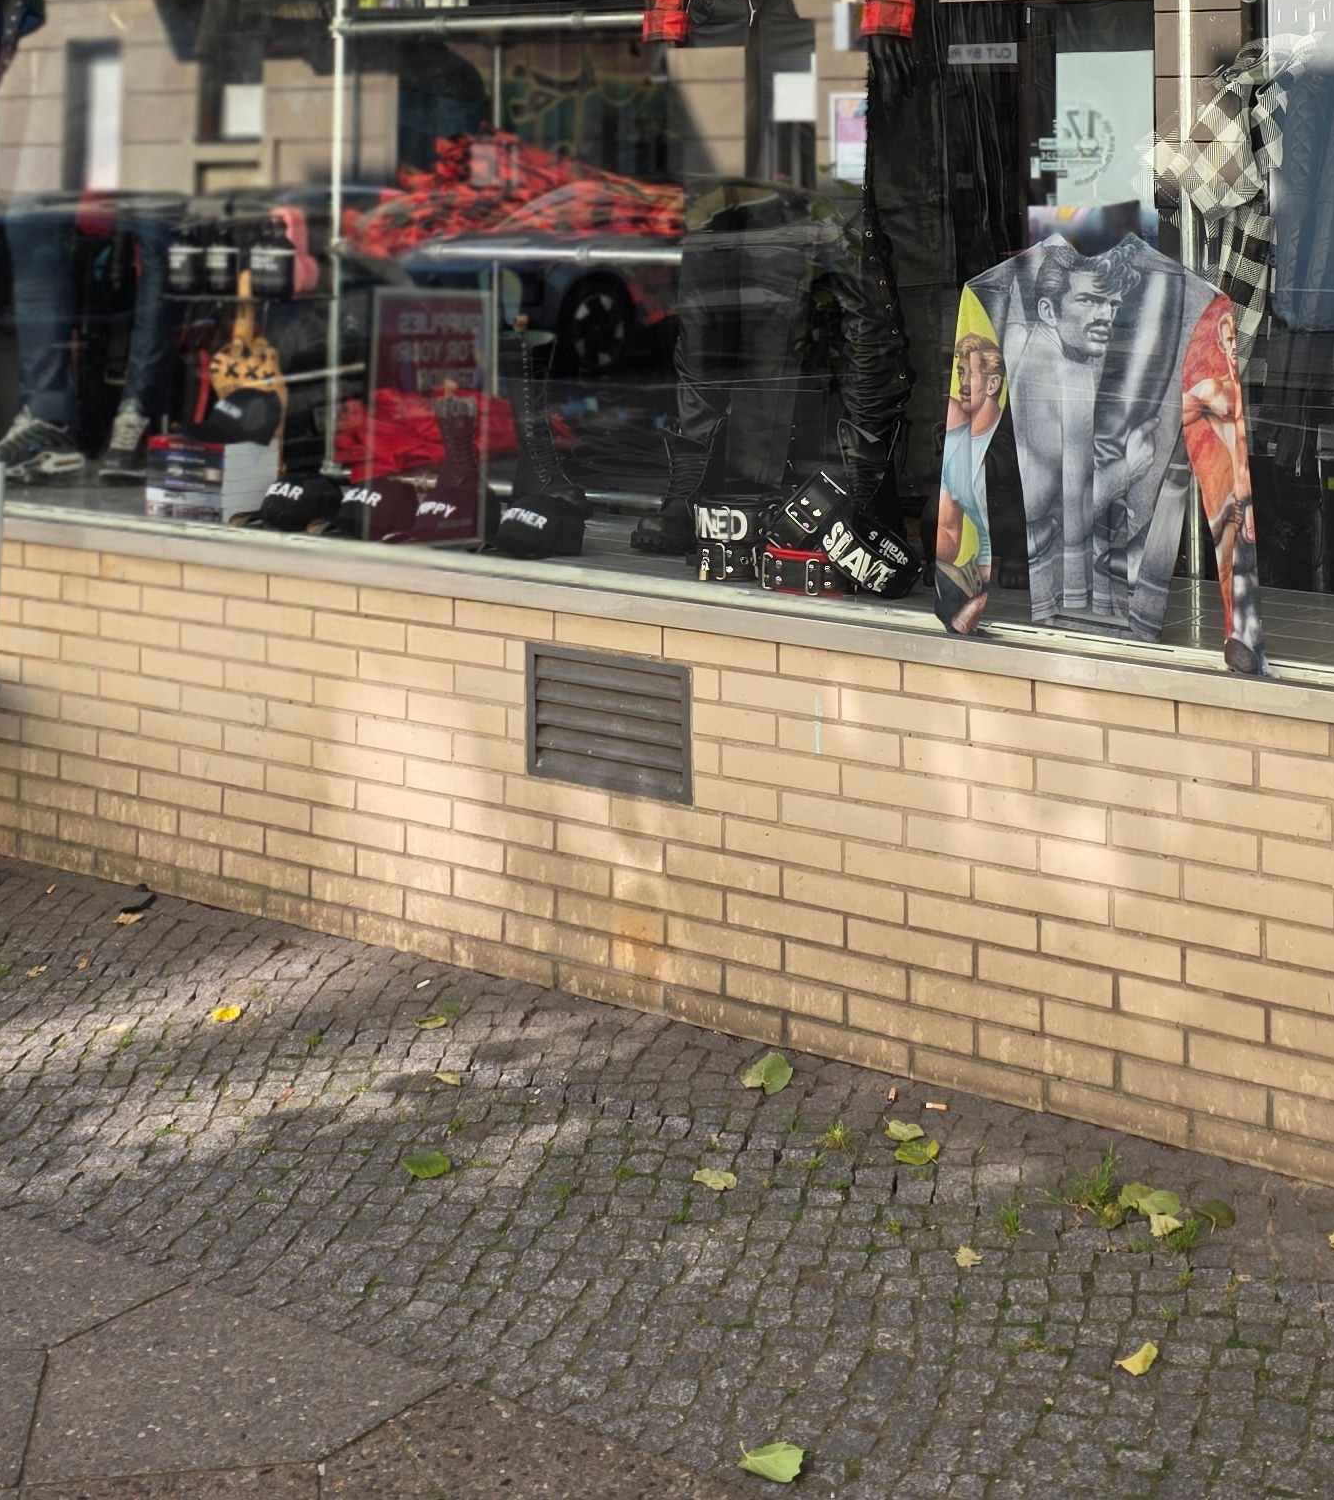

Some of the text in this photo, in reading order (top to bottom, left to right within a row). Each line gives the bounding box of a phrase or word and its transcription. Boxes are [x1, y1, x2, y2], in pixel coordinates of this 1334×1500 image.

[265, 481, 304, 501] EAR
[341, 487, 382, 507] EAR
[696, 505, 749, 541] NED
[822, 520, 897, 593] SLAVE
